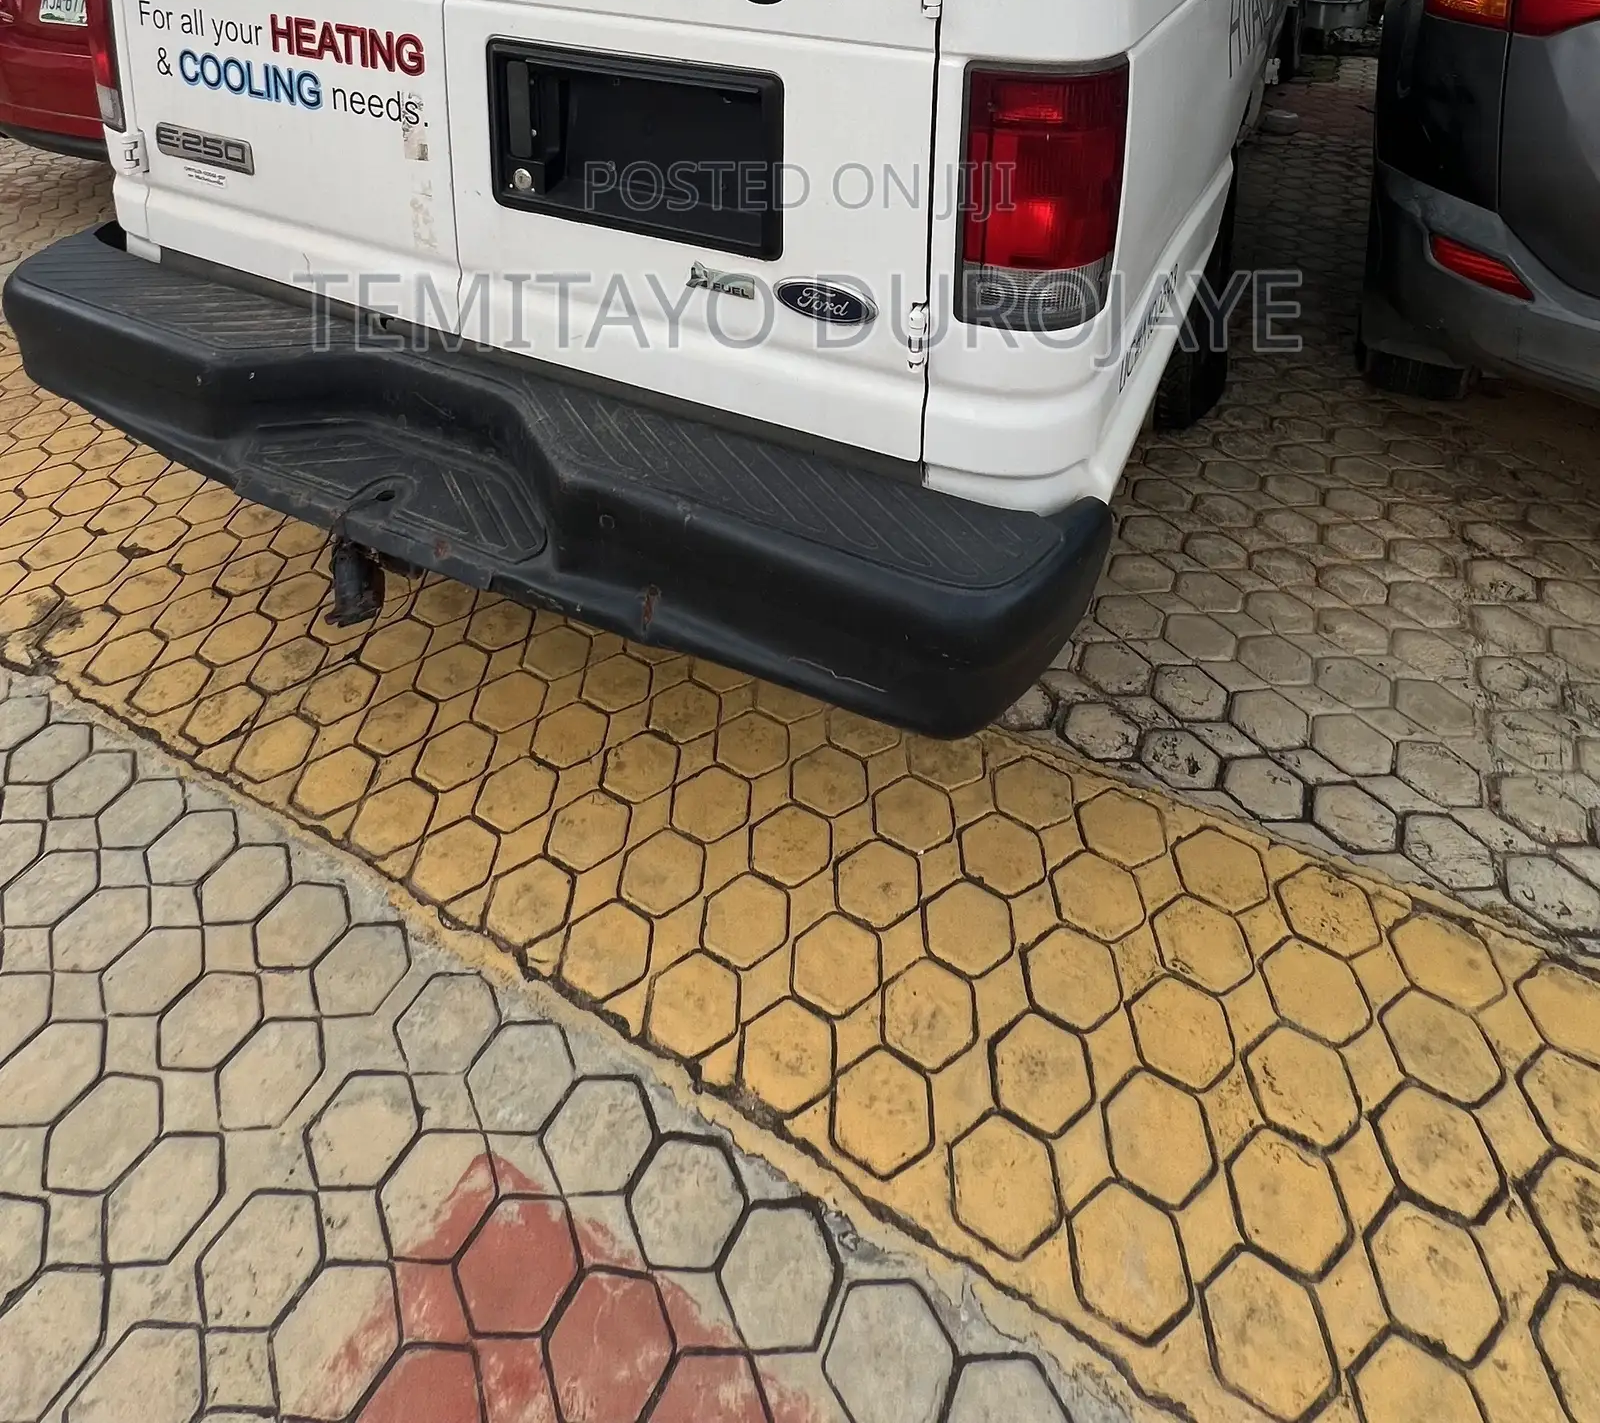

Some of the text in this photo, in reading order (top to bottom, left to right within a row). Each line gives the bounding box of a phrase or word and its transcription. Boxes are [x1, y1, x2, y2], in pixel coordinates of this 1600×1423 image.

[138, 0, 425, 76] For all your HEATING
[156, 46, 429, 127] & COOLING needs.
[711, 281, 750, 298] FUEL
[796, 287, 850, 317] Ford
